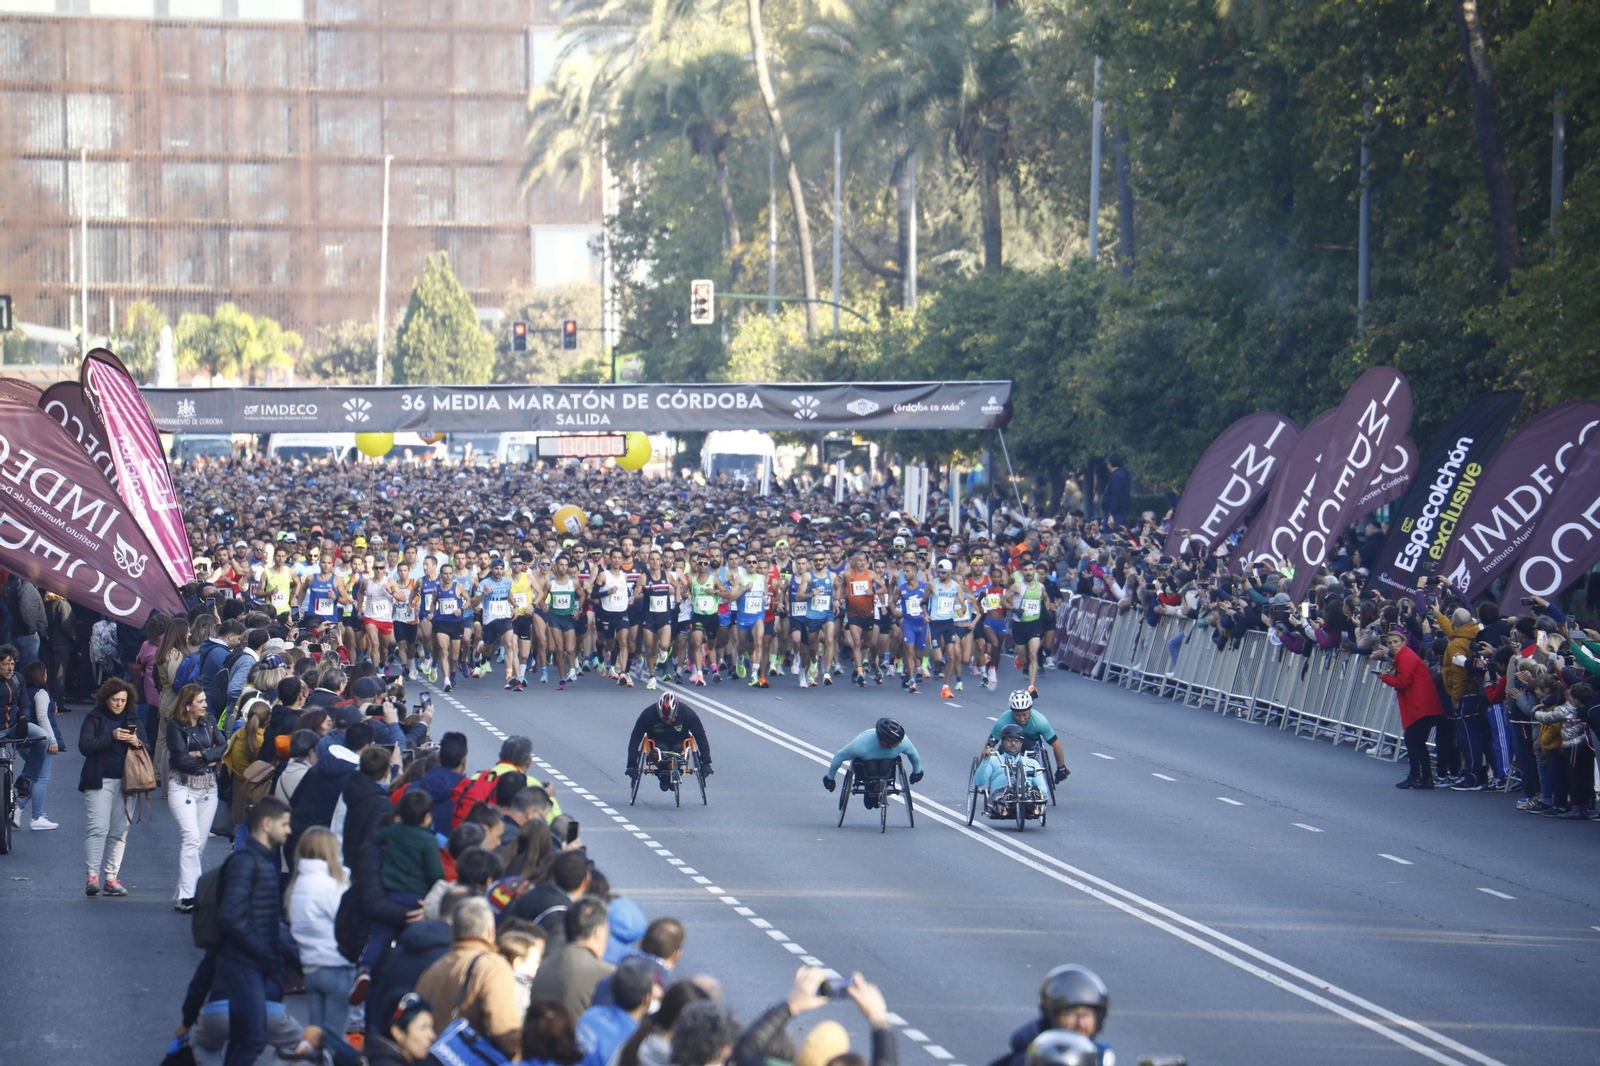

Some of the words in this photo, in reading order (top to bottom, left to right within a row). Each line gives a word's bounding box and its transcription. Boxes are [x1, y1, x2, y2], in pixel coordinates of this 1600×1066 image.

[261, 404, 318, 416] IMDECO
[401, 394, 426, 411] 36
[433, 393, 501, 410] MEDIA
[508, 390, 615, 410] MARATÓN
[623, 393, 649, 410] DE
[656, 389, 764, 410] CÓRDOBA
[556, 413, 611, 425] SALIDA
[1302, 376, 1401, 566] IMDECO
[1394, 436, 1474, 573] Especolchón
[1428, 462, 1482, 560] exclusive
[1482, 546, 1514, 573] Instituto
